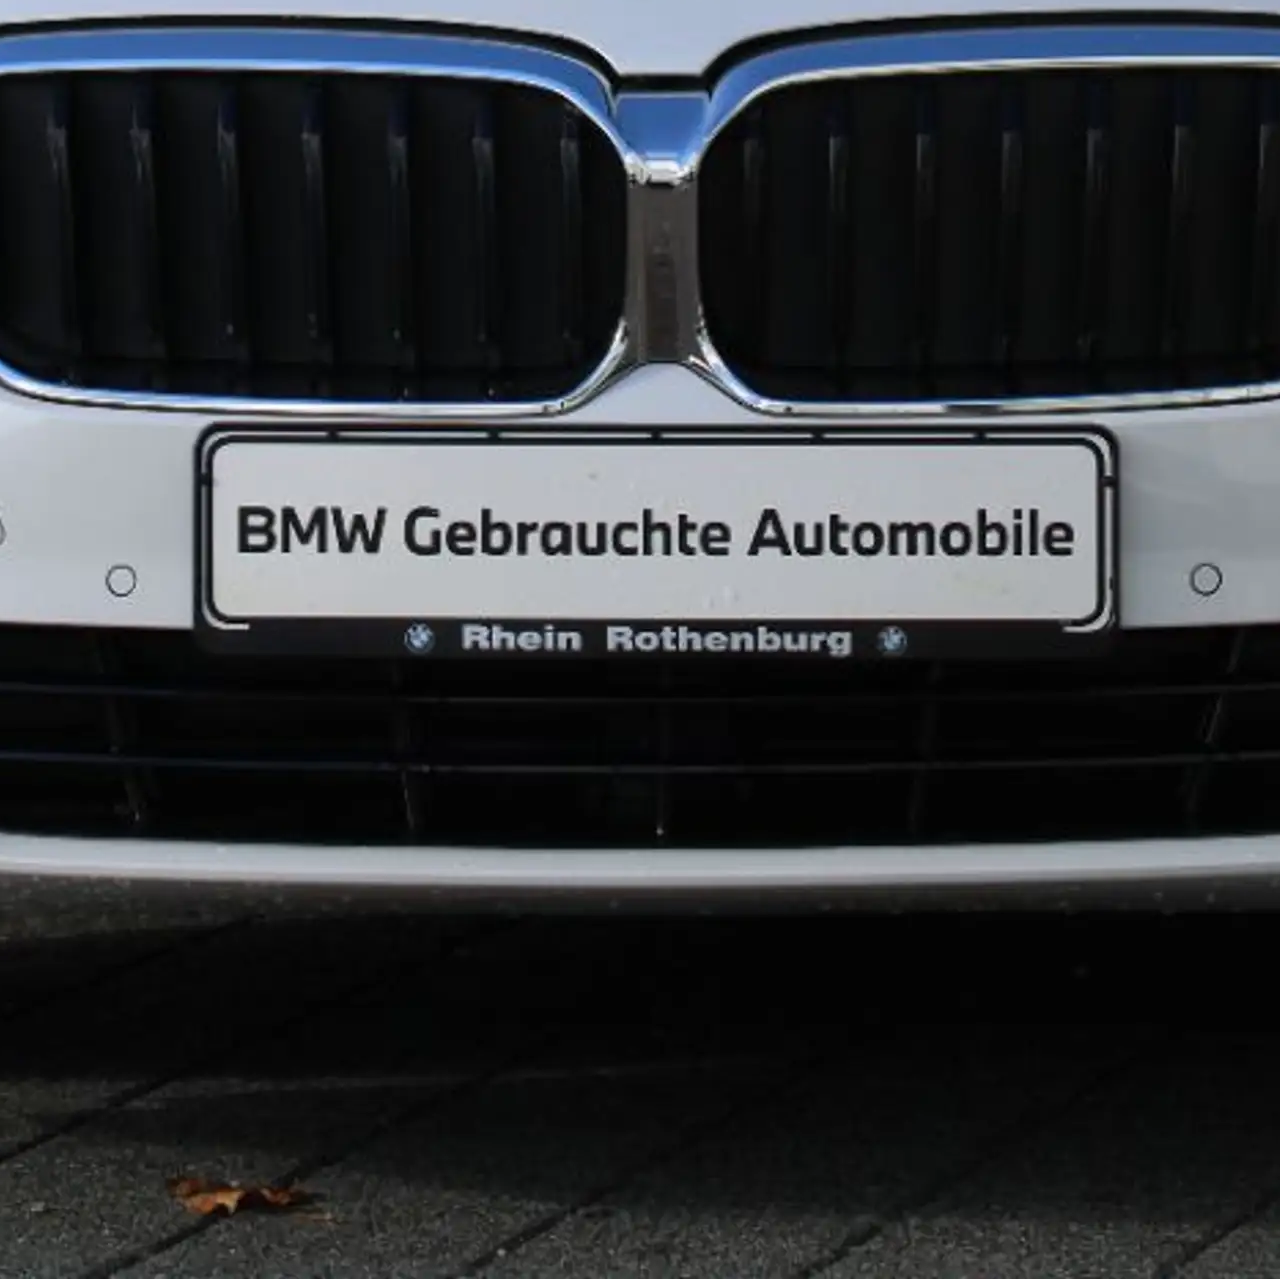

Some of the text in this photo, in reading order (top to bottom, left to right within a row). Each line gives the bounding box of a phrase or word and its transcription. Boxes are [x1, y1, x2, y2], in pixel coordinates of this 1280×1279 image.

[237, 505, 1075, 557] BMW Gebrauchte Automobile
[461, 624, 853, 656] Rhein Rothenburg
